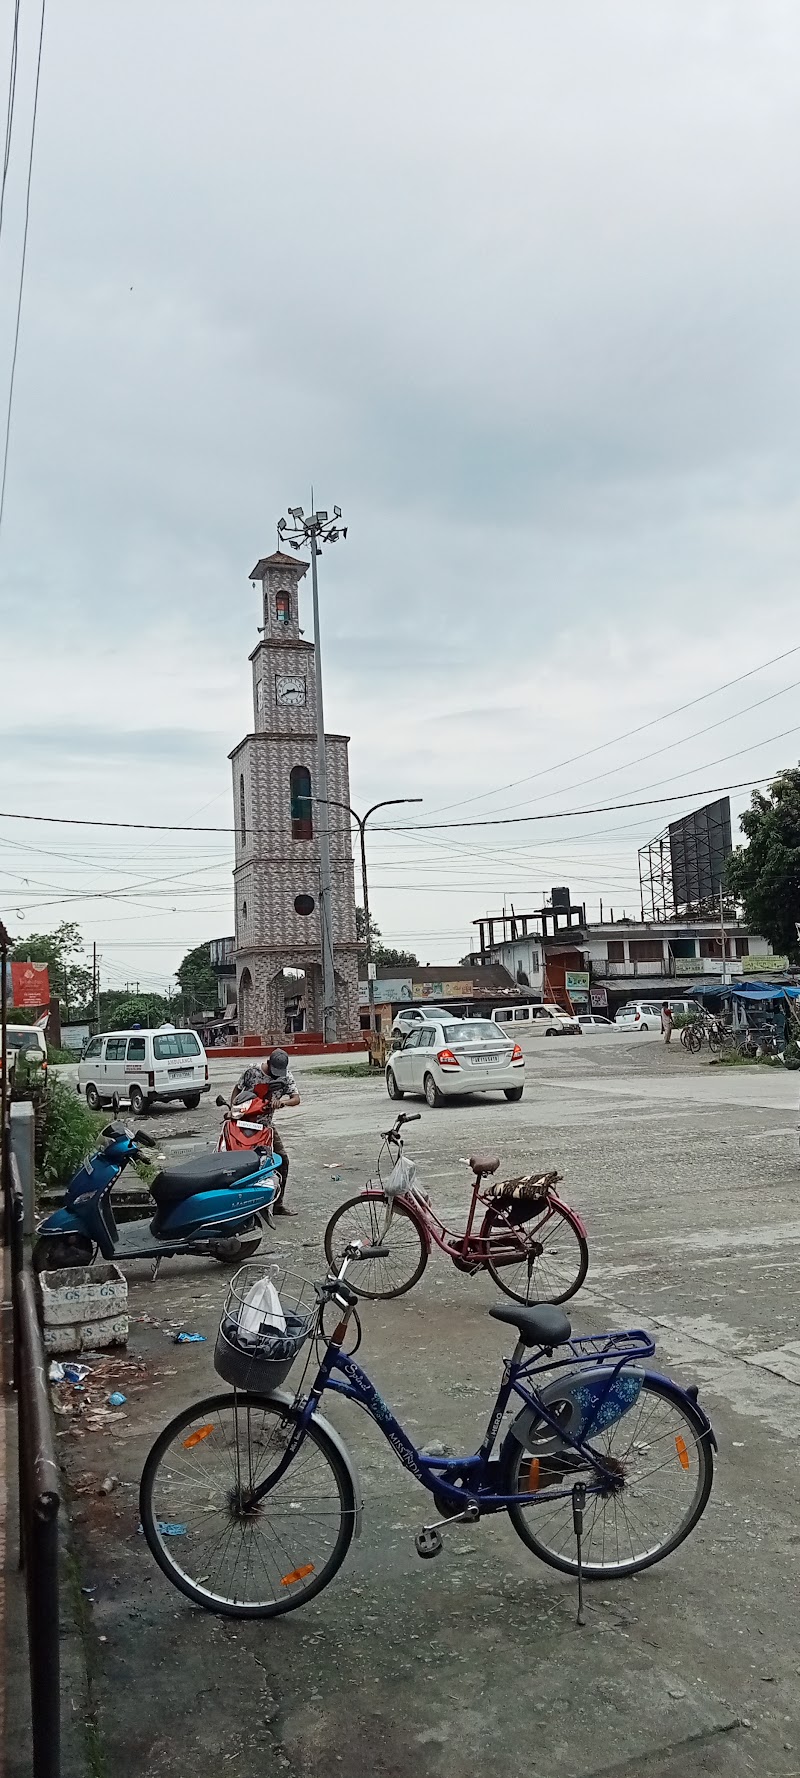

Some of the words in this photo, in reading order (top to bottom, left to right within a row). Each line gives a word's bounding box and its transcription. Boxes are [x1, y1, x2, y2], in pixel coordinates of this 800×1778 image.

[65, 1291, 80, 1300] GS
[100, 1286, 115, 1297] GS
[112, 1322, 127, 1333] GS
[491, 1413, 502, 1435] HERO
